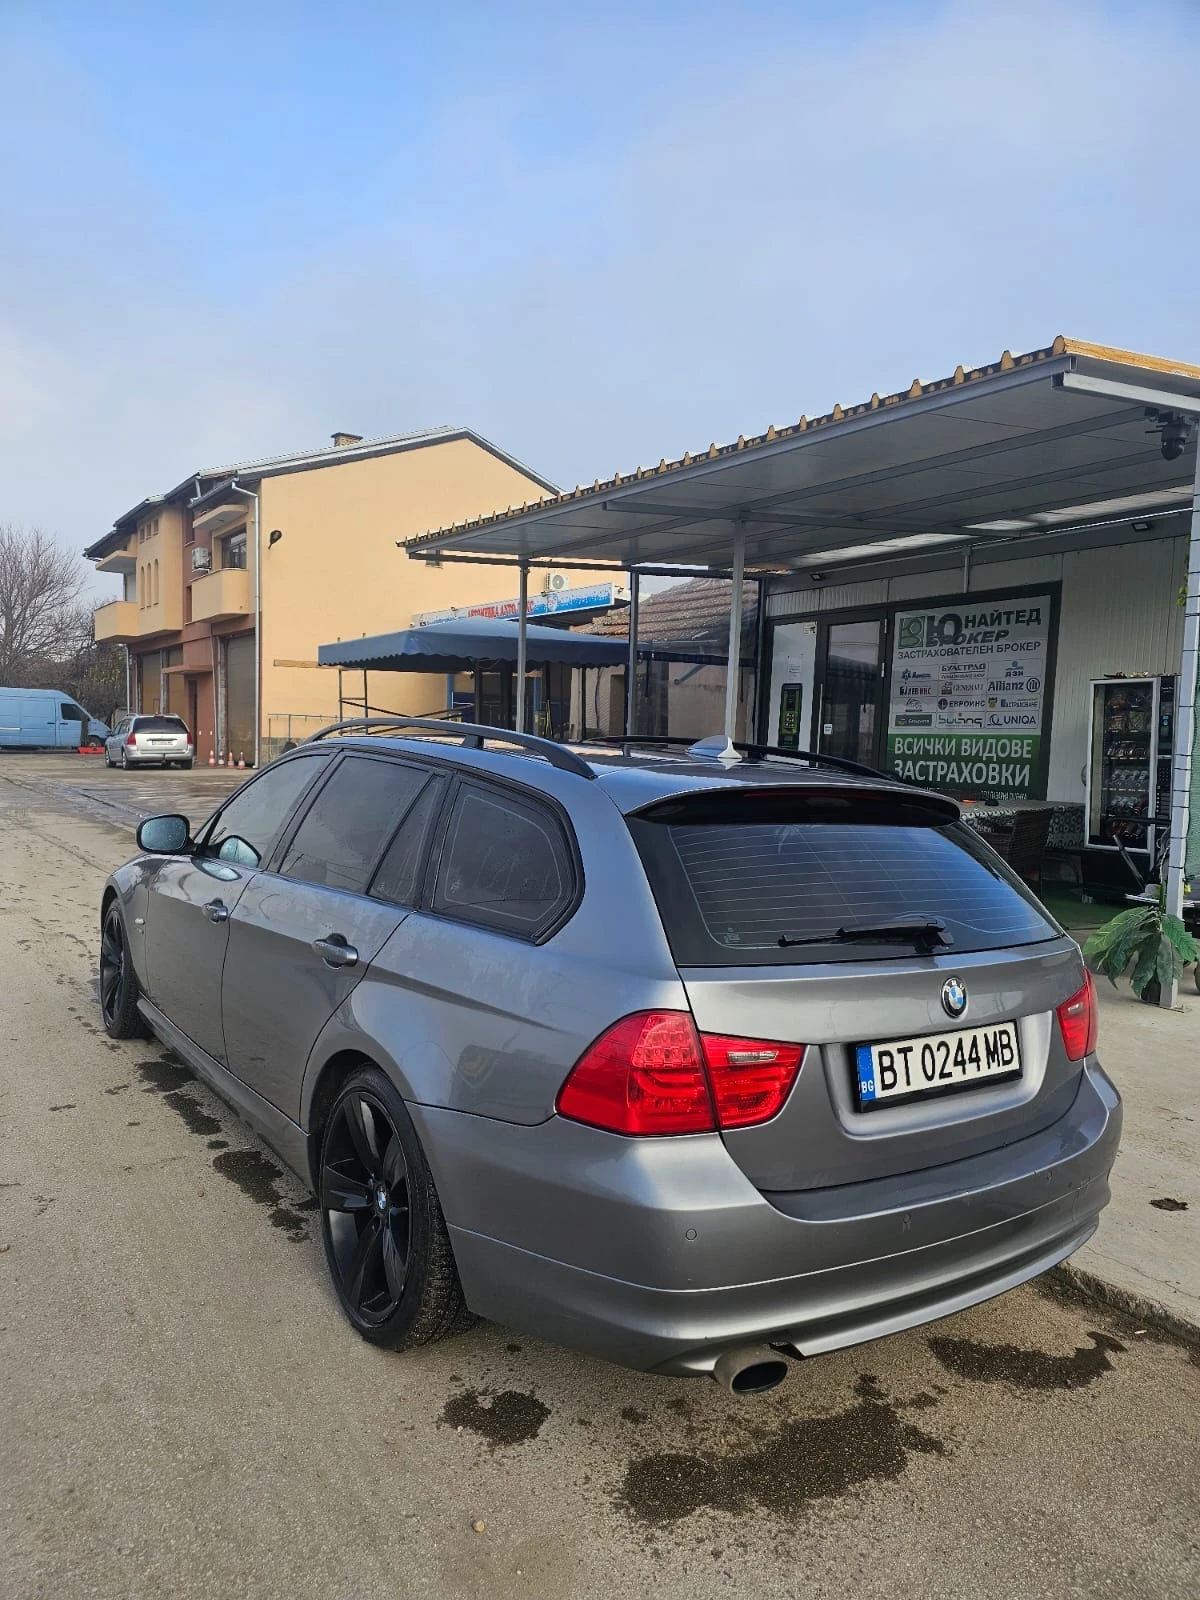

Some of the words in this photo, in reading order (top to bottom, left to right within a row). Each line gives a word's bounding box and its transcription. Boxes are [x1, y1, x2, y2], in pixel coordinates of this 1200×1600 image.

[926, 629, 1010, 647] БРОКЕР
[898, 644, 994, 660] ЗАСТРАХОВАТЕЛЕН
[996, 641, 1041, 653] БРОКЕР
[988, 679, 1024, 692] Allianz
[1003, 715, 1036, 725] UNIQA
[894, 737, 956, 756] ВСИЧКИ
[961, 738, 1033, 761] ВИДОВЕ
[894, 760, 1031, 787] ЗАСТРАХОВКИ
[920, 1034, 982, 1082] 0244
[983, 1028, 1015, 1070] MB
[860, 1080, 874, 1094] BG
